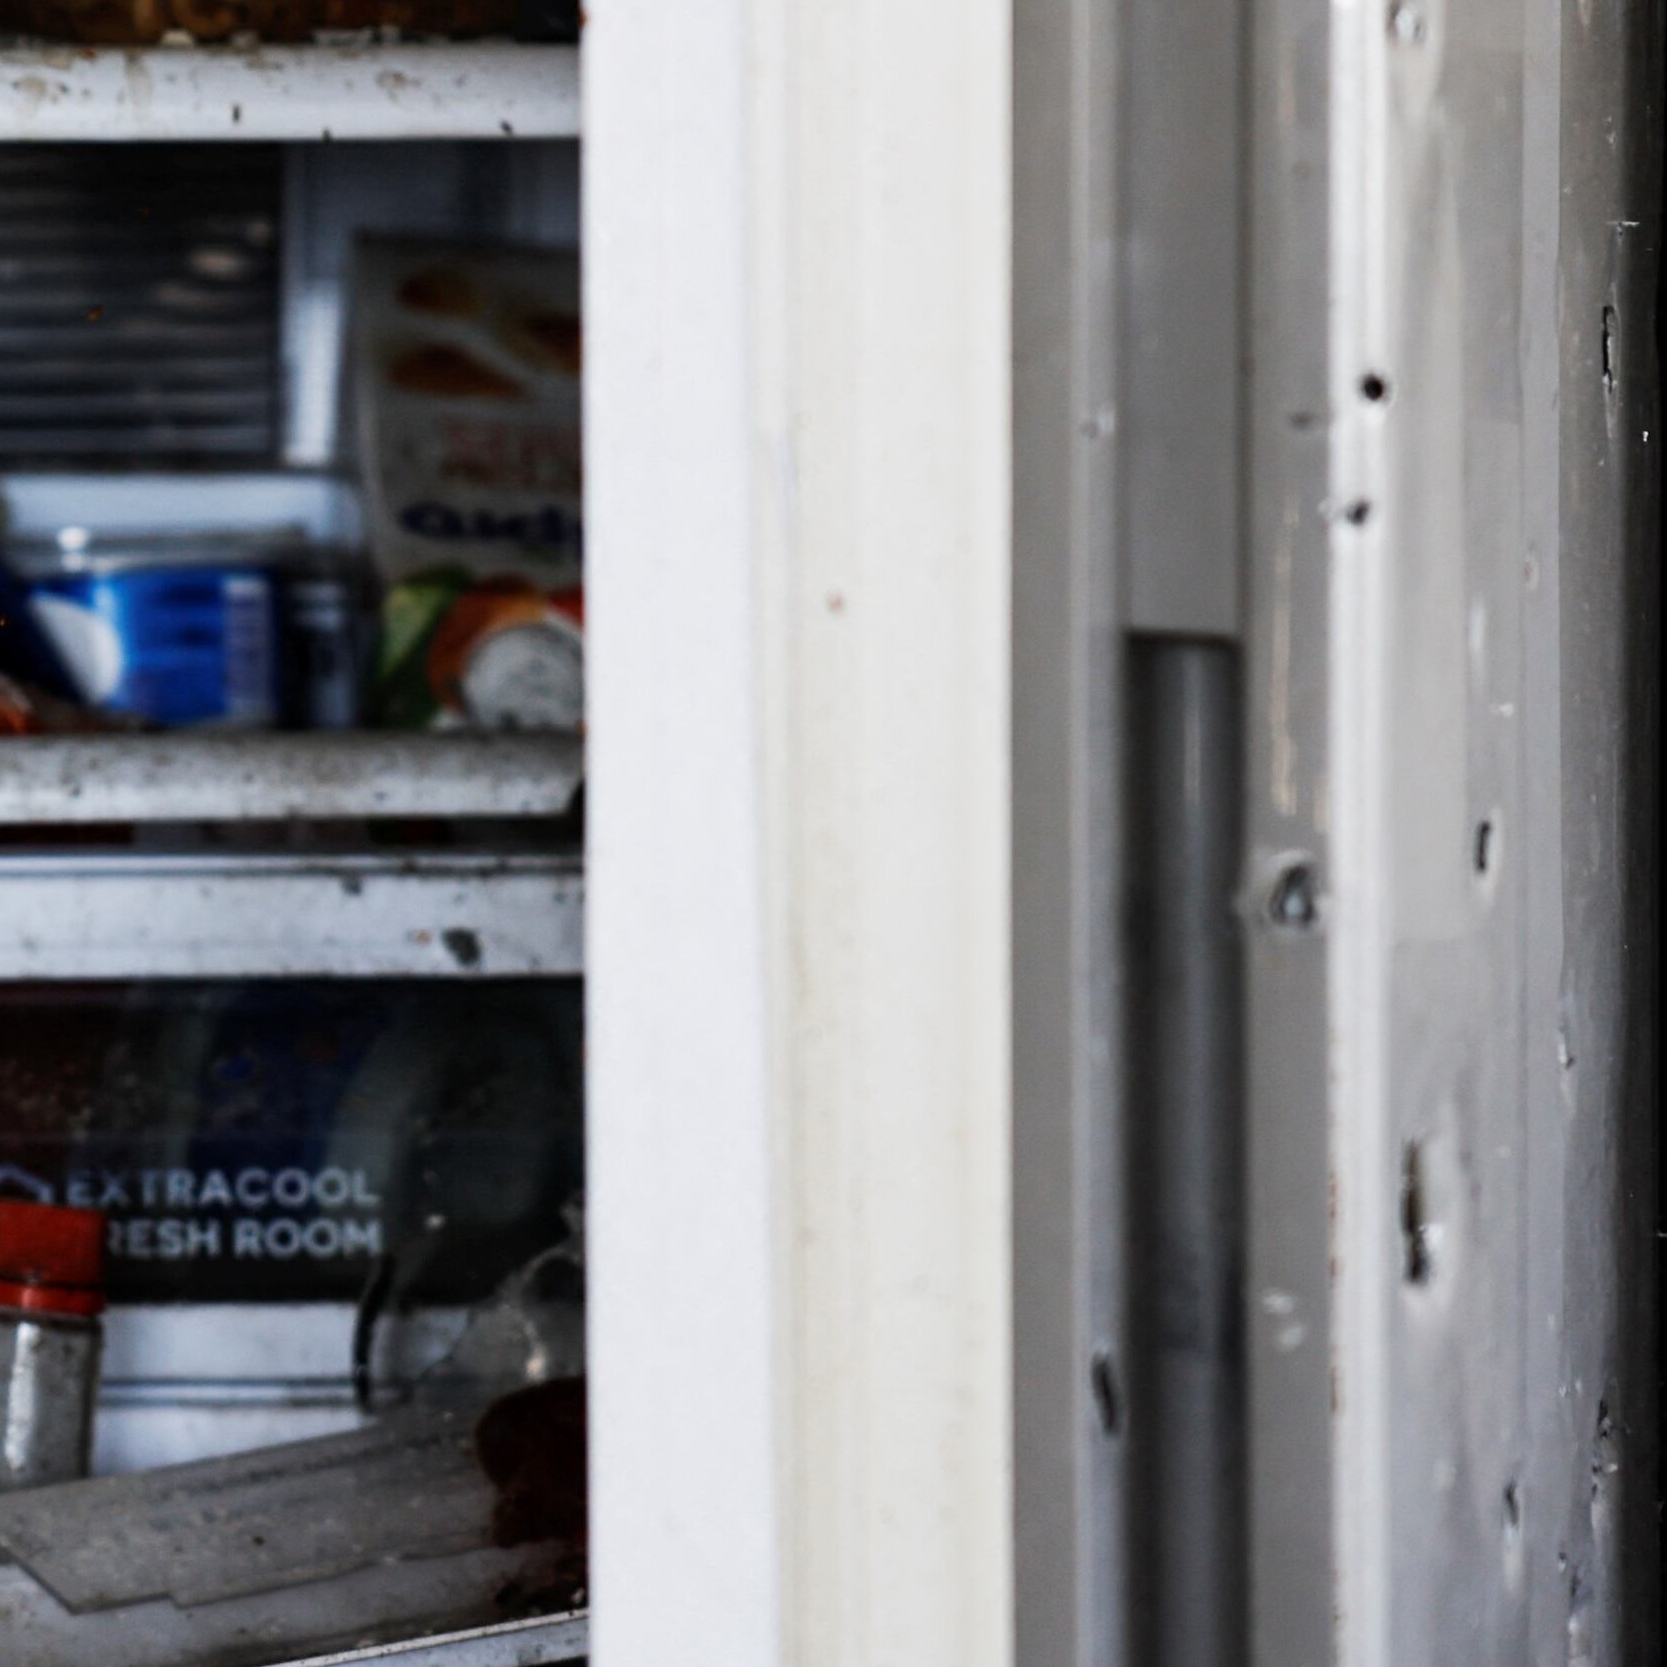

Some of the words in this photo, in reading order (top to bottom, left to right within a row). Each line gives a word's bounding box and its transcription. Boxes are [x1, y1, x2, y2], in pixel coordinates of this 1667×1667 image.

[65, 1166, 381, 1206] EXTRACOOL
[105, 1218, 220, 1257] RESH
[234, 1218, 382, 1257] ROOM
